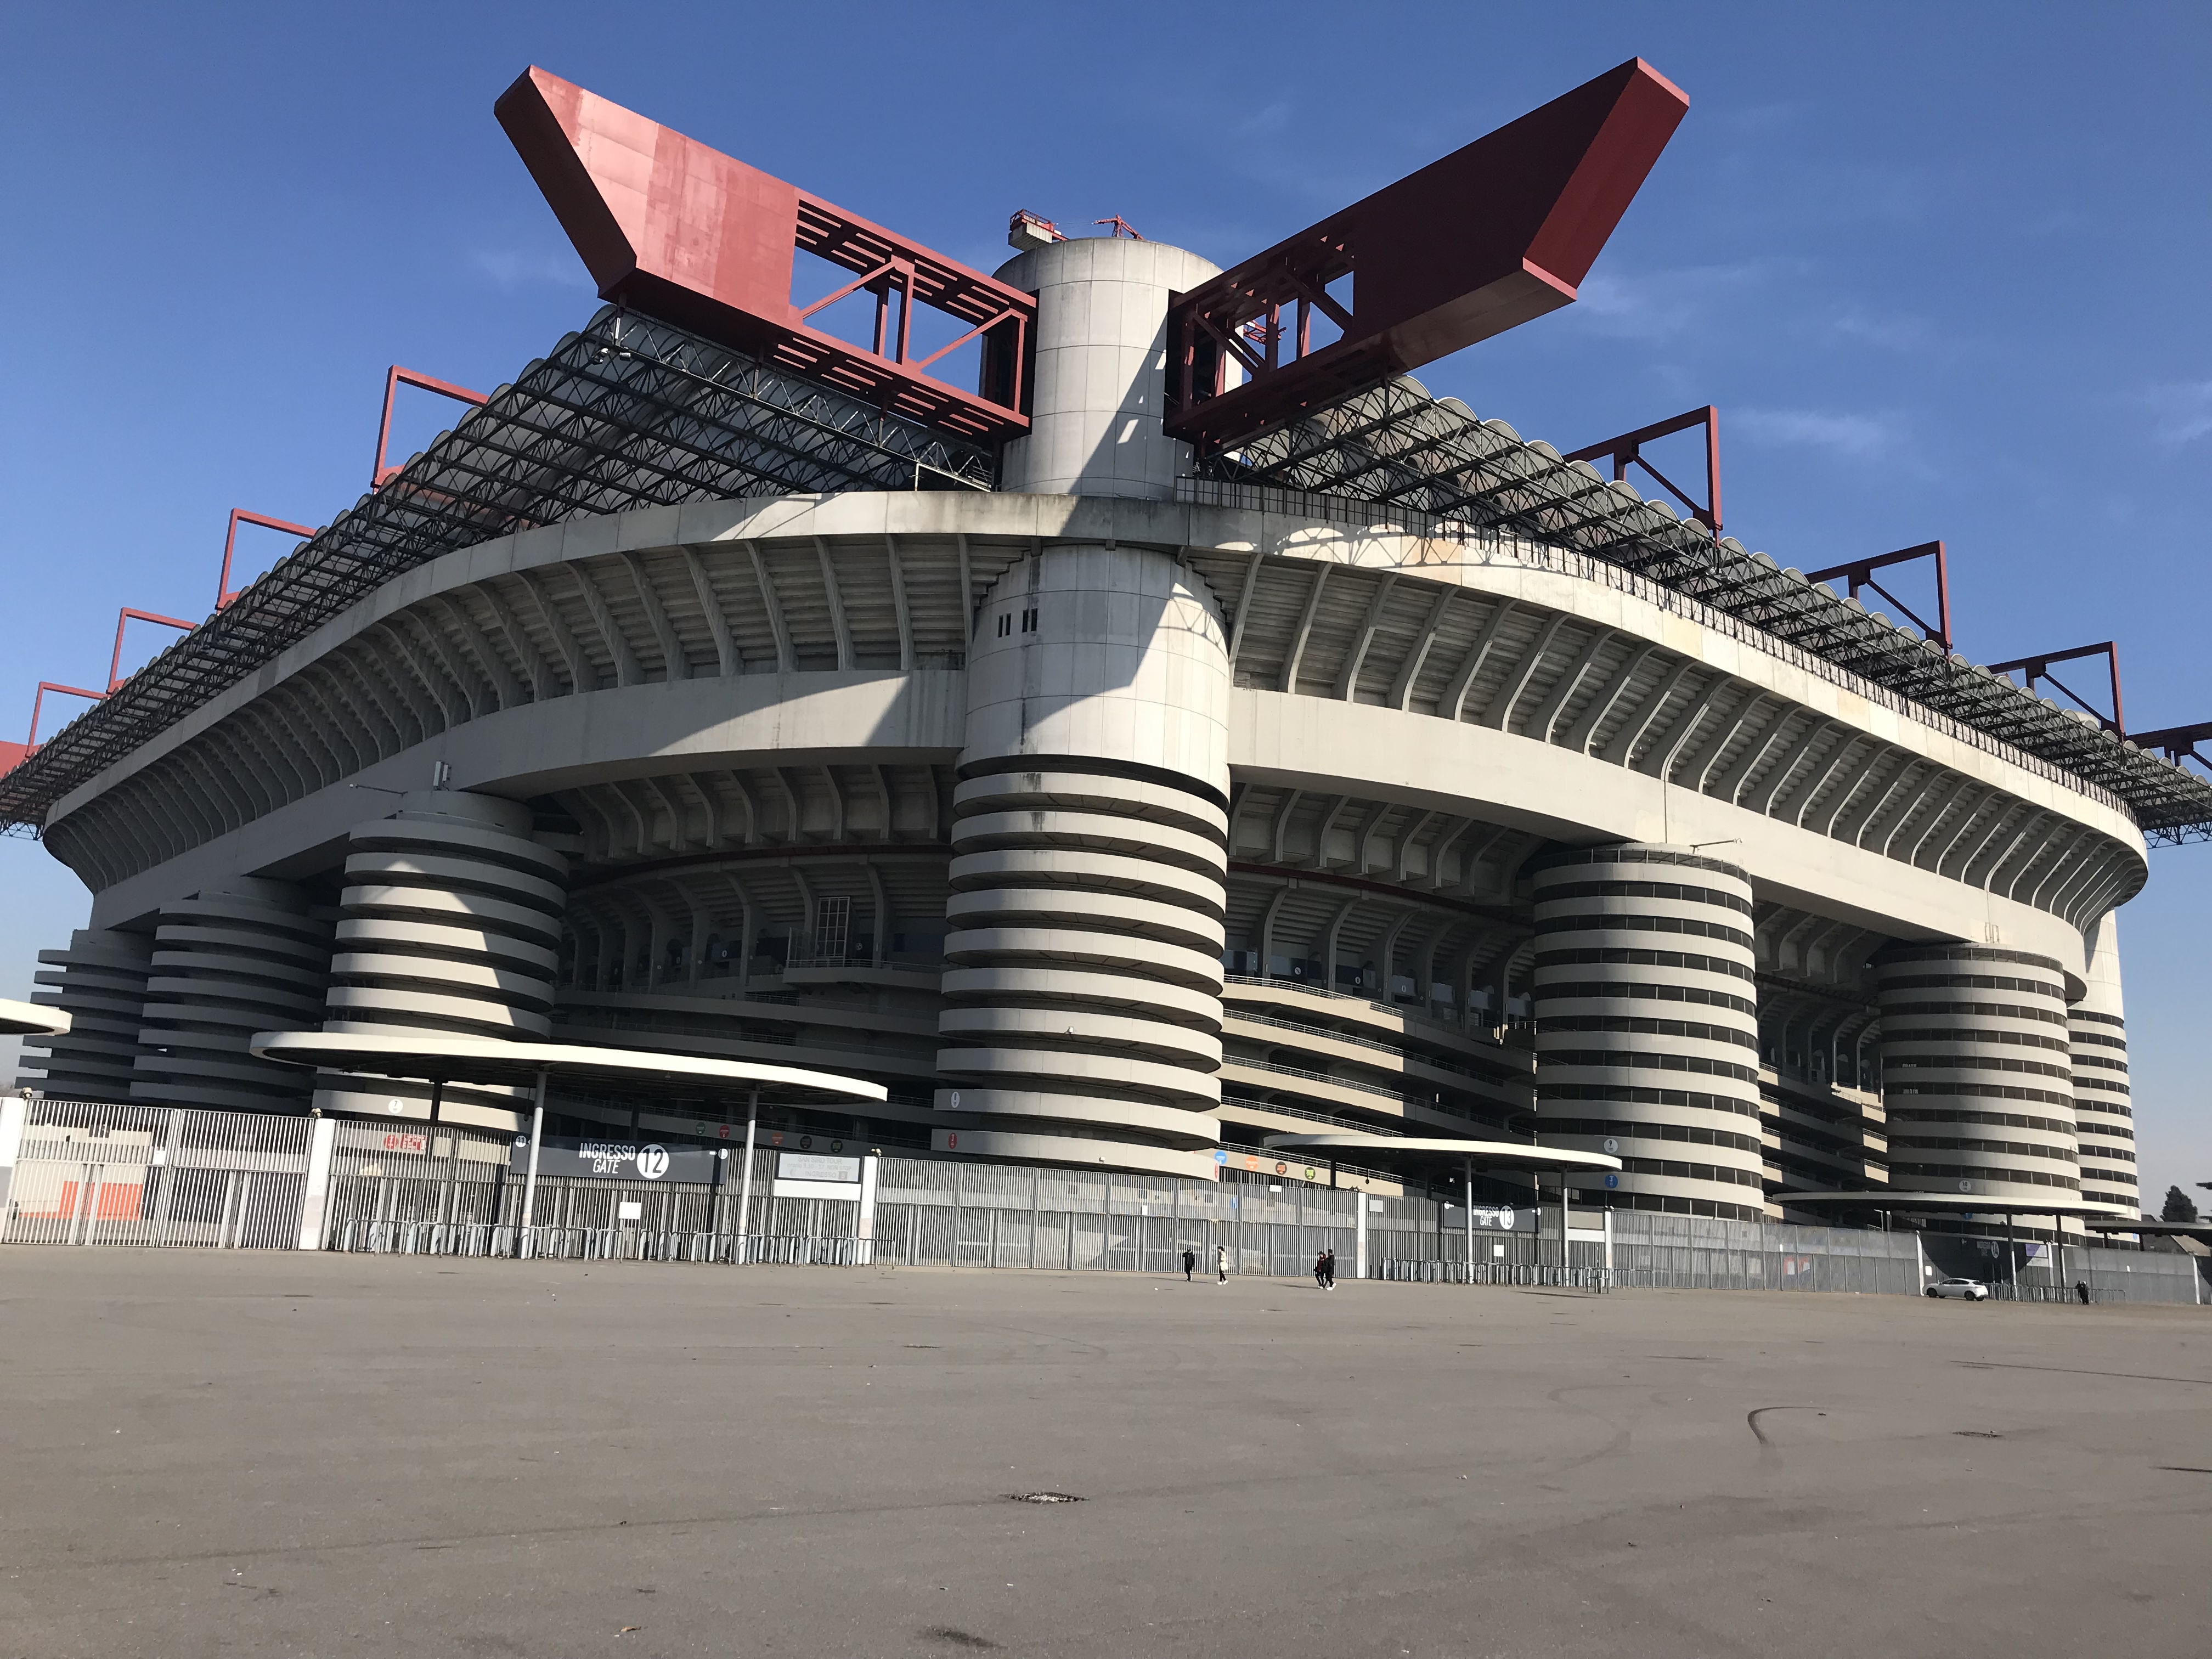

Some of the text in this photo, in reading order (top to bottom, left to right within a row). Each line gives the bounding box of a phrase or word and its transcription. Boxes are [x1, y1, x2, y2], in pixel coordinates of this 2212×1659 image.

[579, 1143, 635, 1160] INGRESSO
[593, 1159, 620, 1173] GATE
[640, 1148, 664, 1173] 12
[1473, 1205, 1499, 1217] INGRESSO
[1501, 1208, 1512, 1226] 13
[1480, 1216, 1492, 1226] GATE
